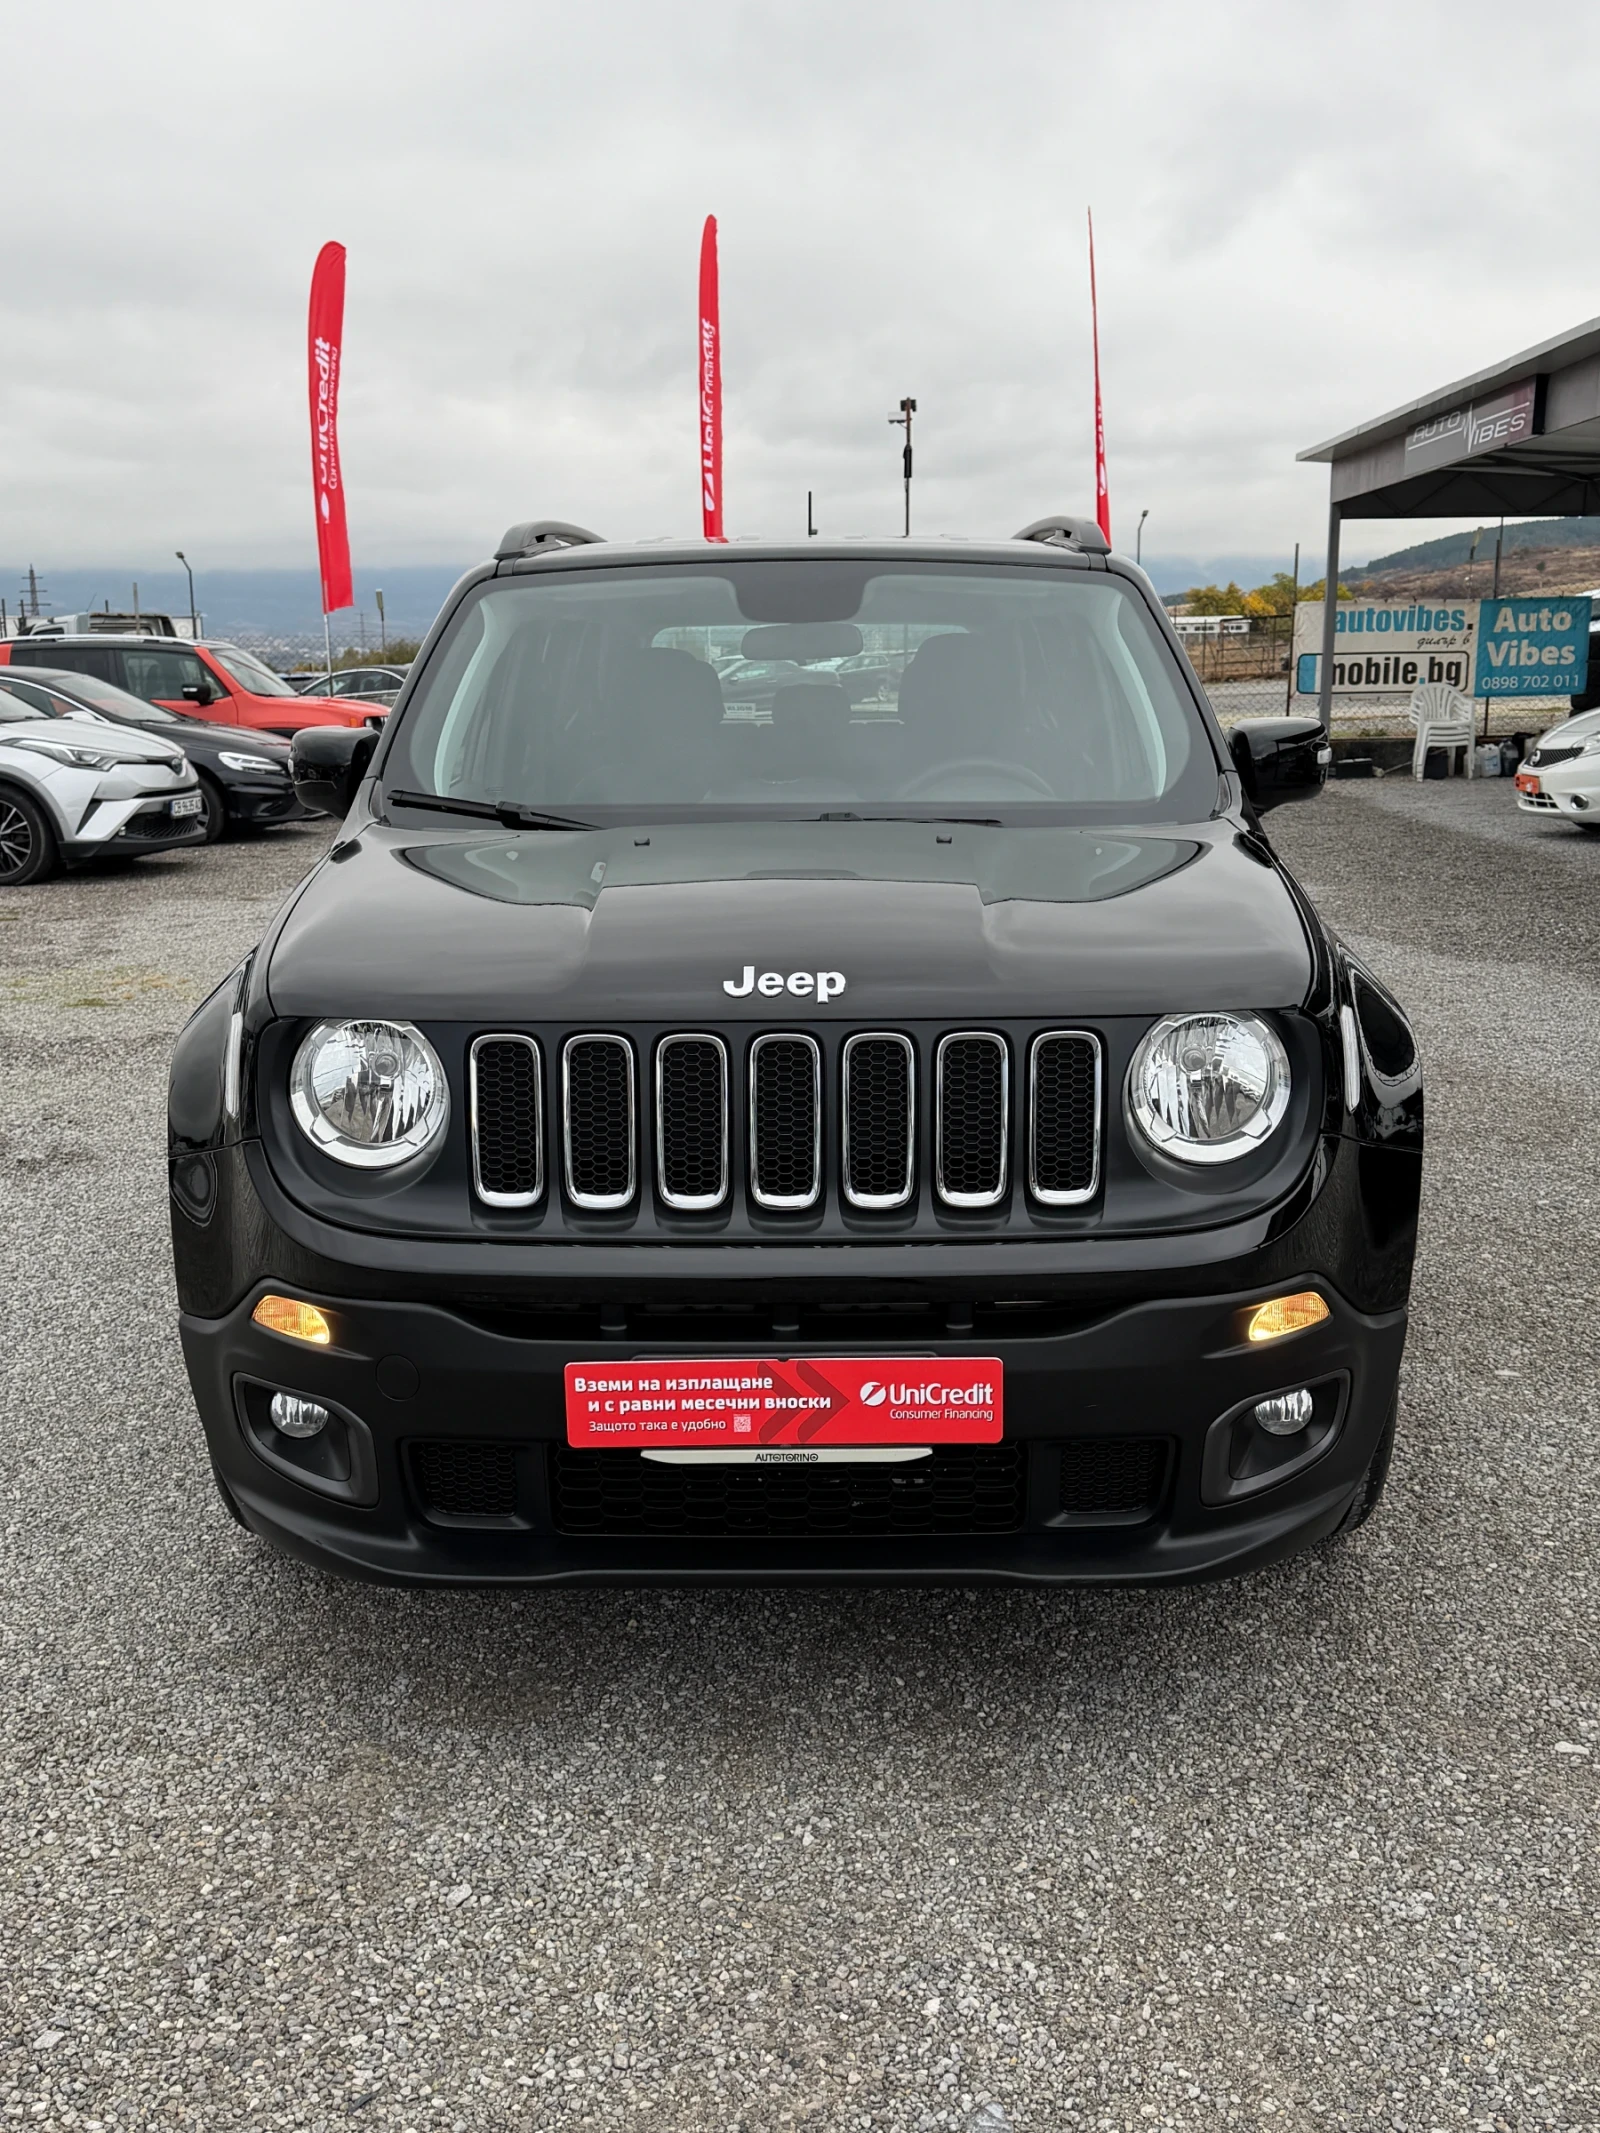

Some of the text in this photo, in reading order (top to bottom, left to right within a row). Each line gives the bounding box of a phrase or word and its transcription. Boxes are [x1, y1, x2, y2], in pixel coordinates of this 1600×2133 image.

[1413, 411, 1461, 442] AUTO
[1493, 607, 1572, 633] Auto
[1486, 639, 1576, 667] Vibes
[1481, 674, 1579, 689] 0898 702 011
[723, 966, 846, 1003] Jeep
[574, 1376, 773, 1392] Вземи на изплащане
[890, 1383, 993, 1405] UniCredit
[588, 1397, 831, 1414] и с равни месечни вноски
[890, 1408, 993, 1421] Consumer Financing
[589, 1418, 726, 1432] Защото така е удобно
[755, 1453, 819, 1462] AUTOTORINO
